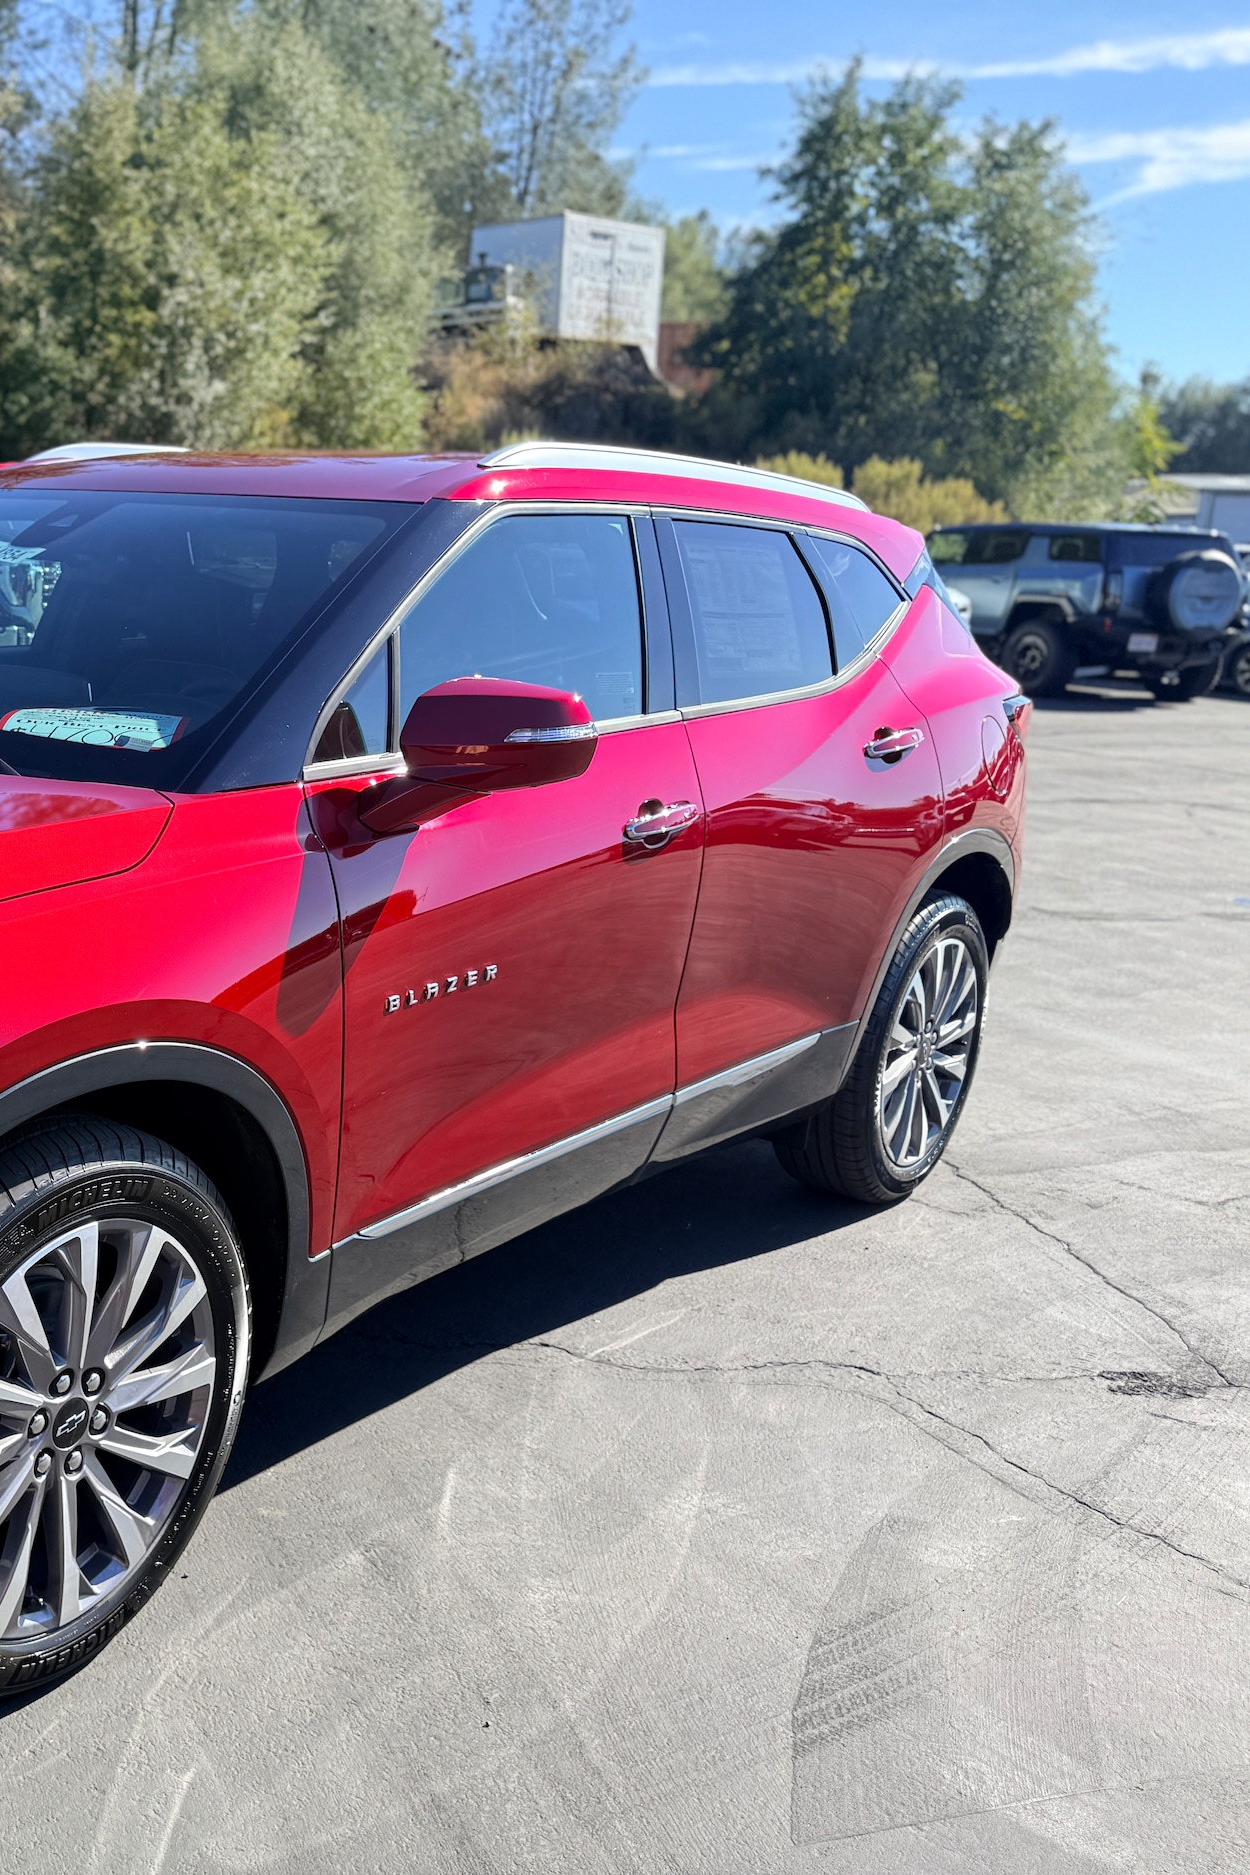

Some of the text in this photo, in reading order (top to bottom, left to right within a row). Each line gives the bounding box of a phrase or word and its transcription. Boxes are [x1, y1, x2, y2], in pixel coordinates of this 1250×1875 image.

[384, 964, 498, 1013] BLAZER
[37, 1180, 148, 1231] MICHELIN
[15, 1608, 125, 1682] MICHELIN
